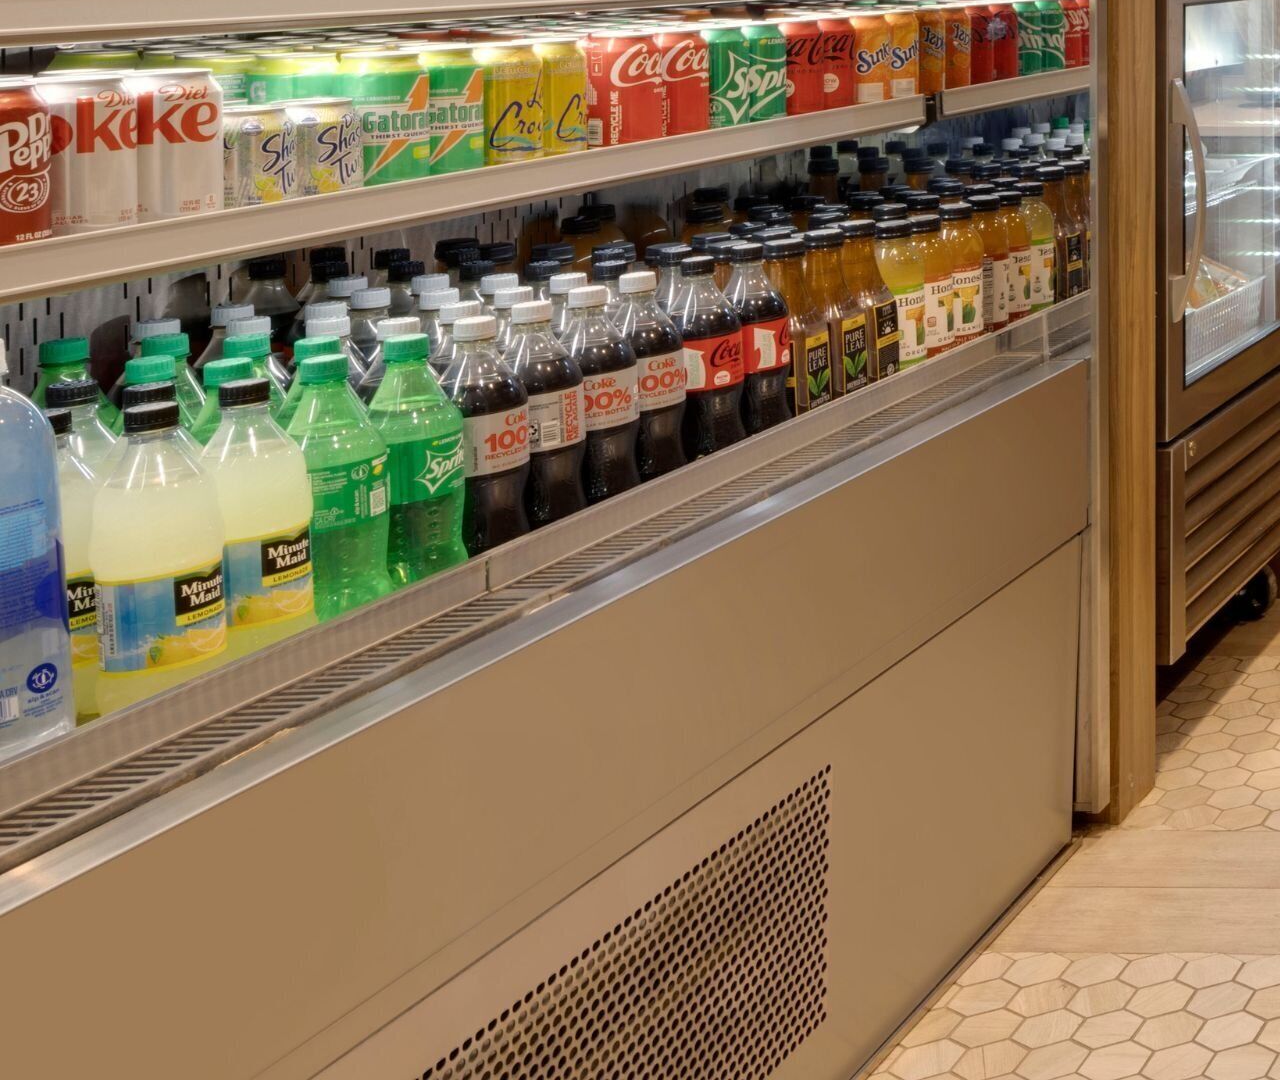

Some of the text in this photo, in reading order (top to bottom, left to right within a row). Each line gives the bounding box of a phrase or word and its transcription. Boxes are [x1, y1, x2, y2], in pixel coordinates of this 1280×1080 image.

[158, 83, 210, 103] Diet
[610, 90, 619, 145] RECYCLE ME
[370, 132, 401, 140] THIRST
[430, 123, 460, 132] THIRST
[16, 181, 40, 203] 23
[15, 233, 25, 241] 12
[845, 328, 865, 344] PURE
[808, 346, 828, 362] PURE
[648, 357, 677, 371] Coke
[584, 377, 617, 392] Coke
[564, 393, 573, 442] RECYCLE
[485, 423, 528, 454] 100
[484, 447, 524, 461] RECYCLED
[267, 538, 310, 560] Minute
[276, 552, 307, 569] Maid
[273, 566, 309, 584] LEMONADE
[180, 574, 223, 599] Minute
[190, 589, 221, 608] Maid
[187, 604, 223, 622] LEMONADE
